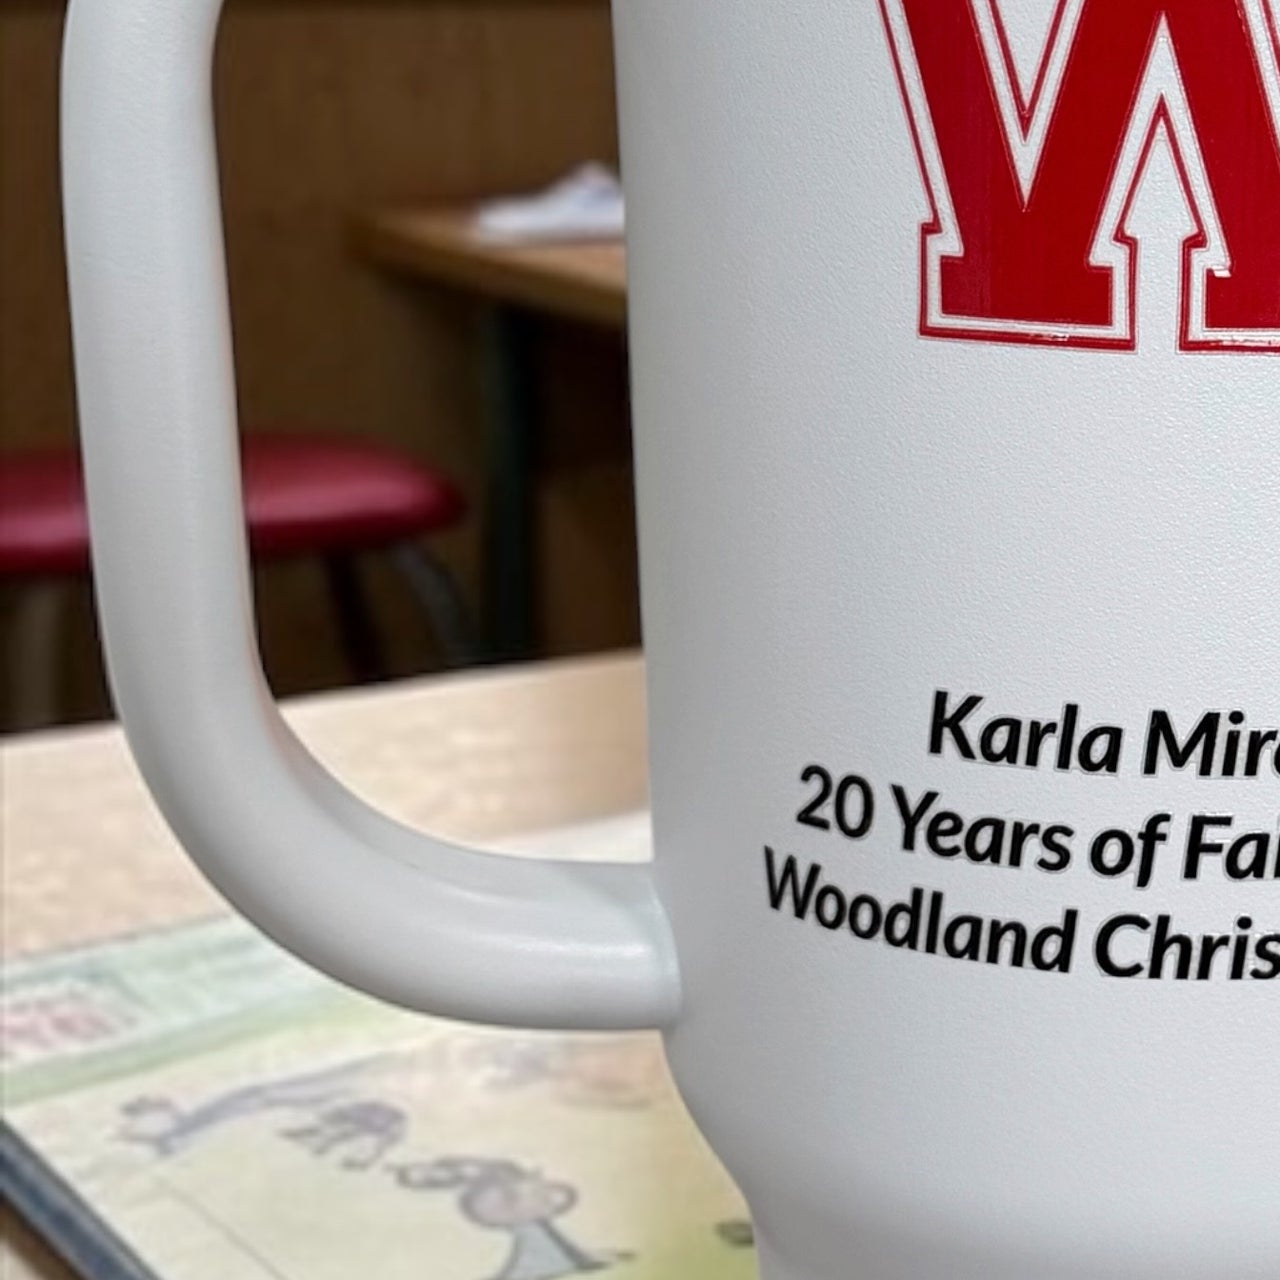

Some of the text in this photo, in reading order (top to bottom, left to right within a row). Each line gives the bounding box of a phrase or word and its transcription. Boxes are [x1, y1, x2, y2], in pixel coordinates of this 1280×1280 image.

[928, 689, 1124, 774] Karla
[796, 764, 875, 840] 20
[890, 783, 1075, 872] Years
[1089, 812, 1172, 889] of
[764, 845, 1079, 974] Woodland
